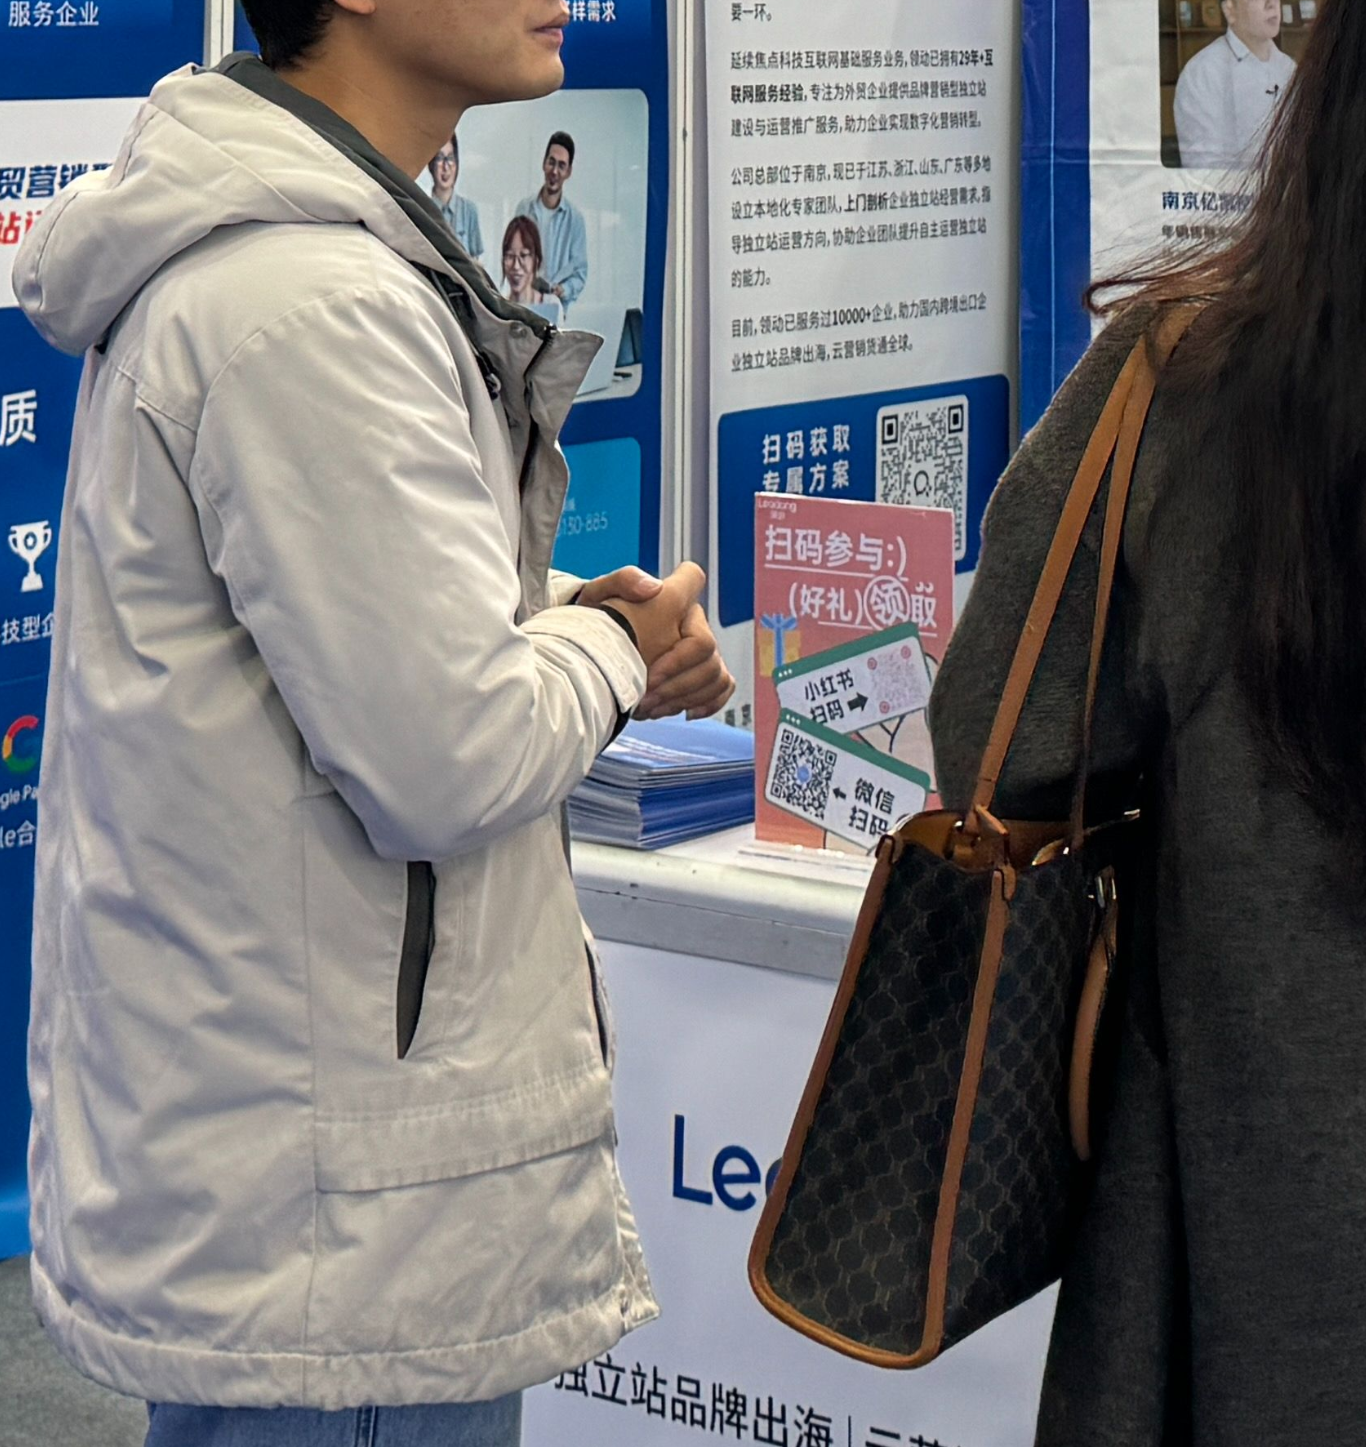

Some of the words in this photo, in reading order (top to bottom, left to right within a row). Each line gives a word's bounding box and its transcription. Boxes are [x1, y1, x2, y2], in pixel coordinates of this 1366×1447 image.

[7, 0, 101, 29] 服务企业
[730, 266, 772, 289] 的能力。
[761, 424, 851, 466] 扫码获取
[761, 459, 851, 494] 专属方案
[804, 667, 855, 702] 小红书
[810, 698, 845, 725] 扫码
[854, 777, 895, 815] 微信
[672, 1114, 782, 1213] Le
